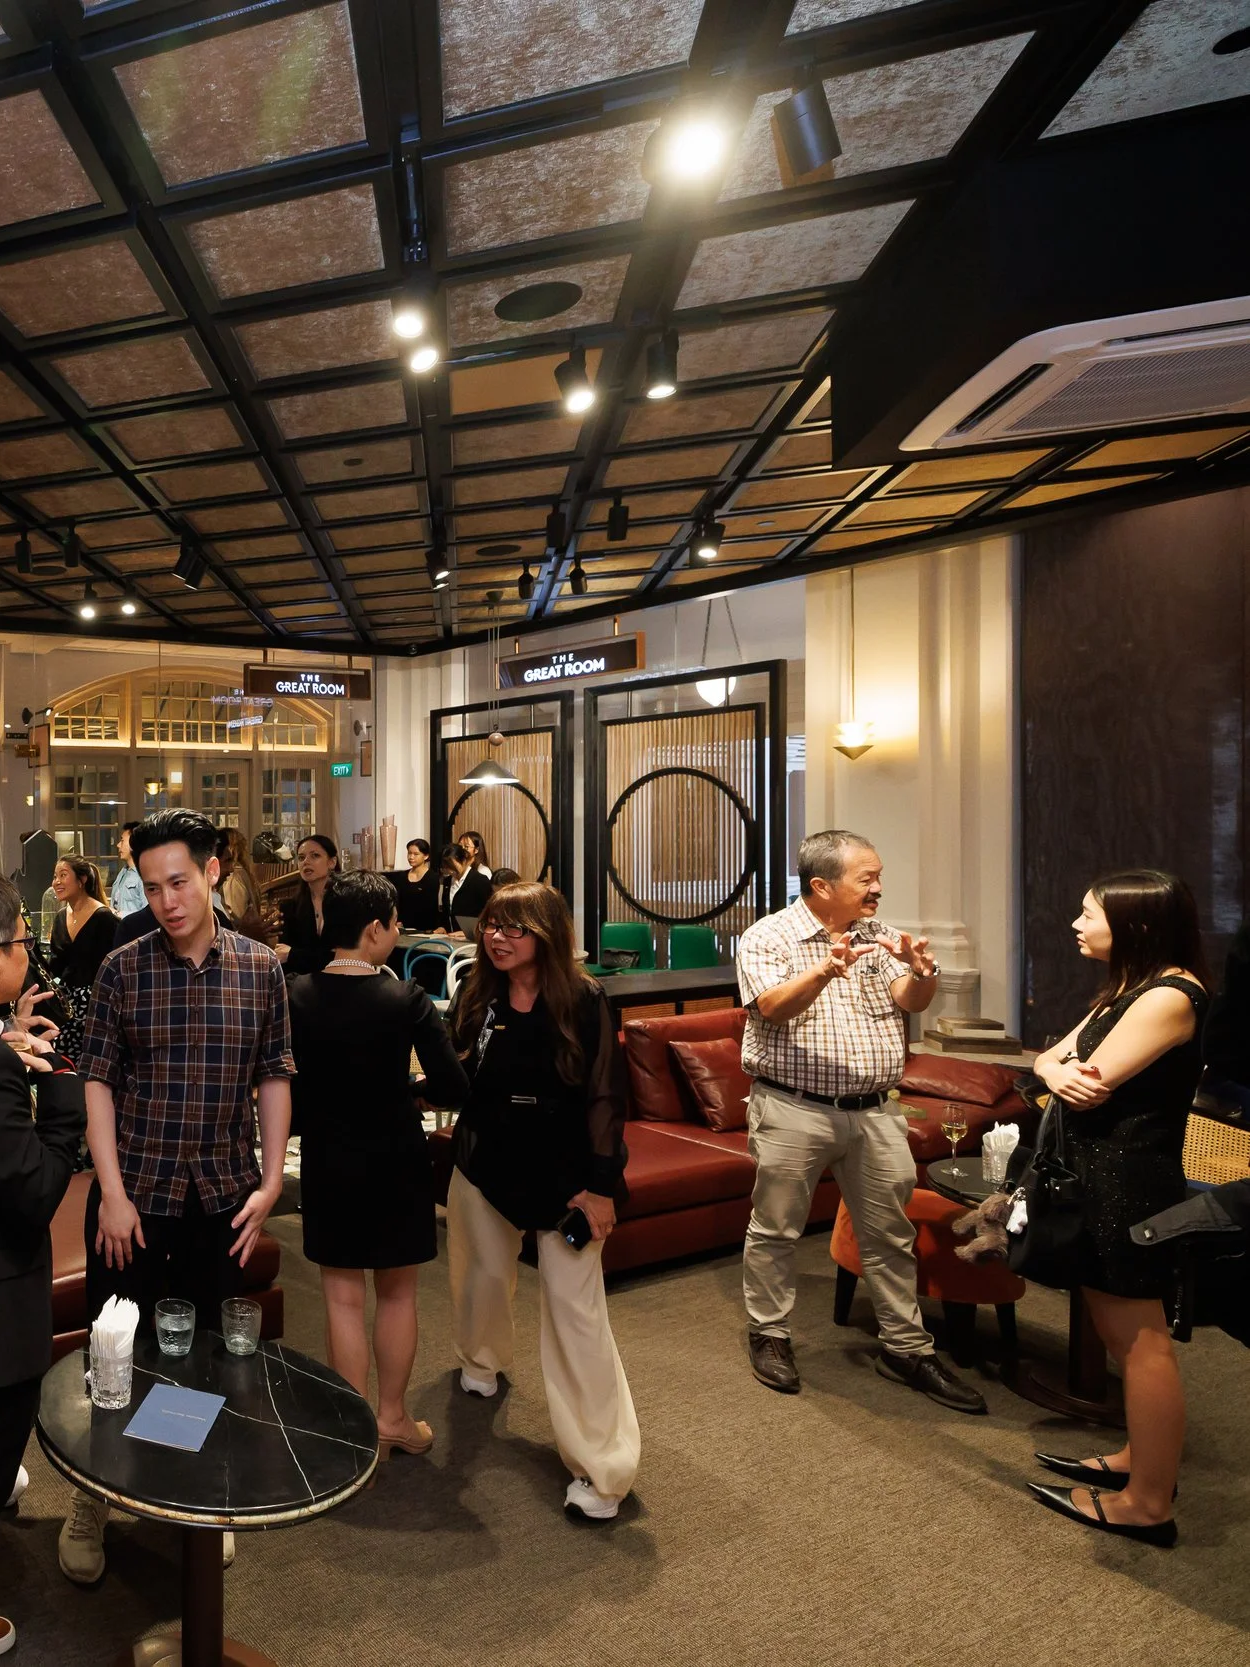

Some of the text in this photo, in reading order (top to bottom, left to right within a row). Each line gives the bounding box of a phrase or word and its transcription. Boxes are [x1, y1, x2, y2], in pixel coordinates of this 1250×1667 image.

[552, 653, 574, 664] THE
[524, 665, 562, 683] GREAT
[565, 657, 605, 677] ROOM
[300, 673, 320, 682] THE
[275, 681, 345, 695] GREAT ROOM
[333, 766, 346, 776] EXIT
